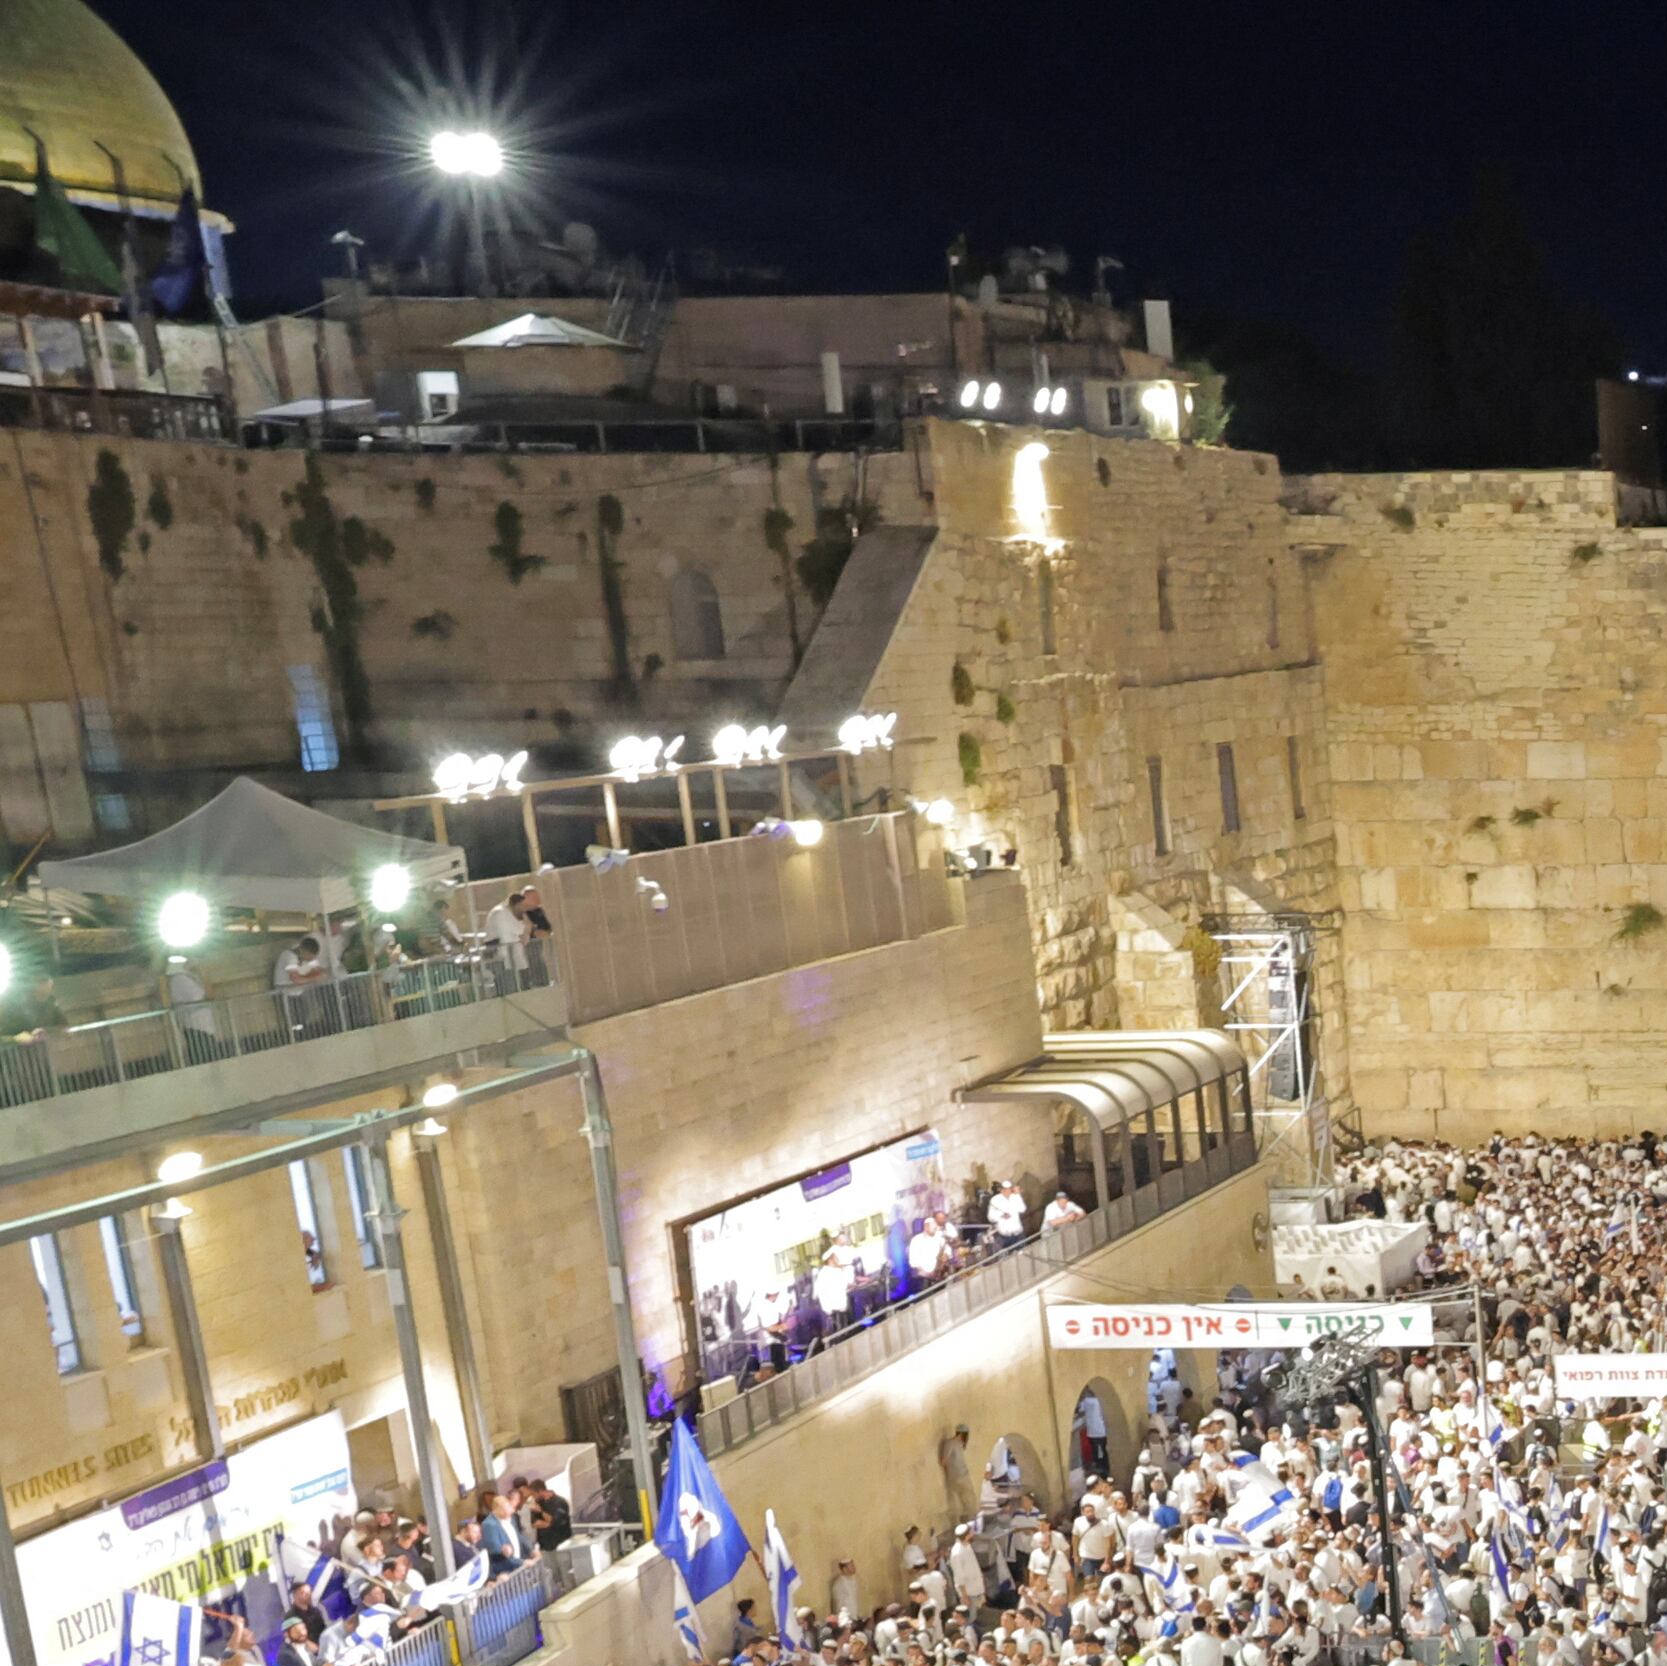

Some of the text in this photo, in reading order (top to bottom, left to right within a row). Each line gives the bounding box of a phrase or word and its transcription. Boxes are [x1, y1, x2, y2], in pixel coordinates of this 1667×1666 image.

[1092, 1315, 1223, 1341] אין כניסה
[1305, 1315, 1385, 1335] כניסה
[1562, 1370, 1603, 1381] רפואי
[1608, 1370, 1640, 1381] צוות
[6, 1455, 97, 1508] TUNNELS
[104, 1433, 153, 1471] SITES
[200, 1534, 259, 1587] ישראל
[177, 1559, 201, 1594] חי
[56, 1598, 116, 1651] ומנצח
